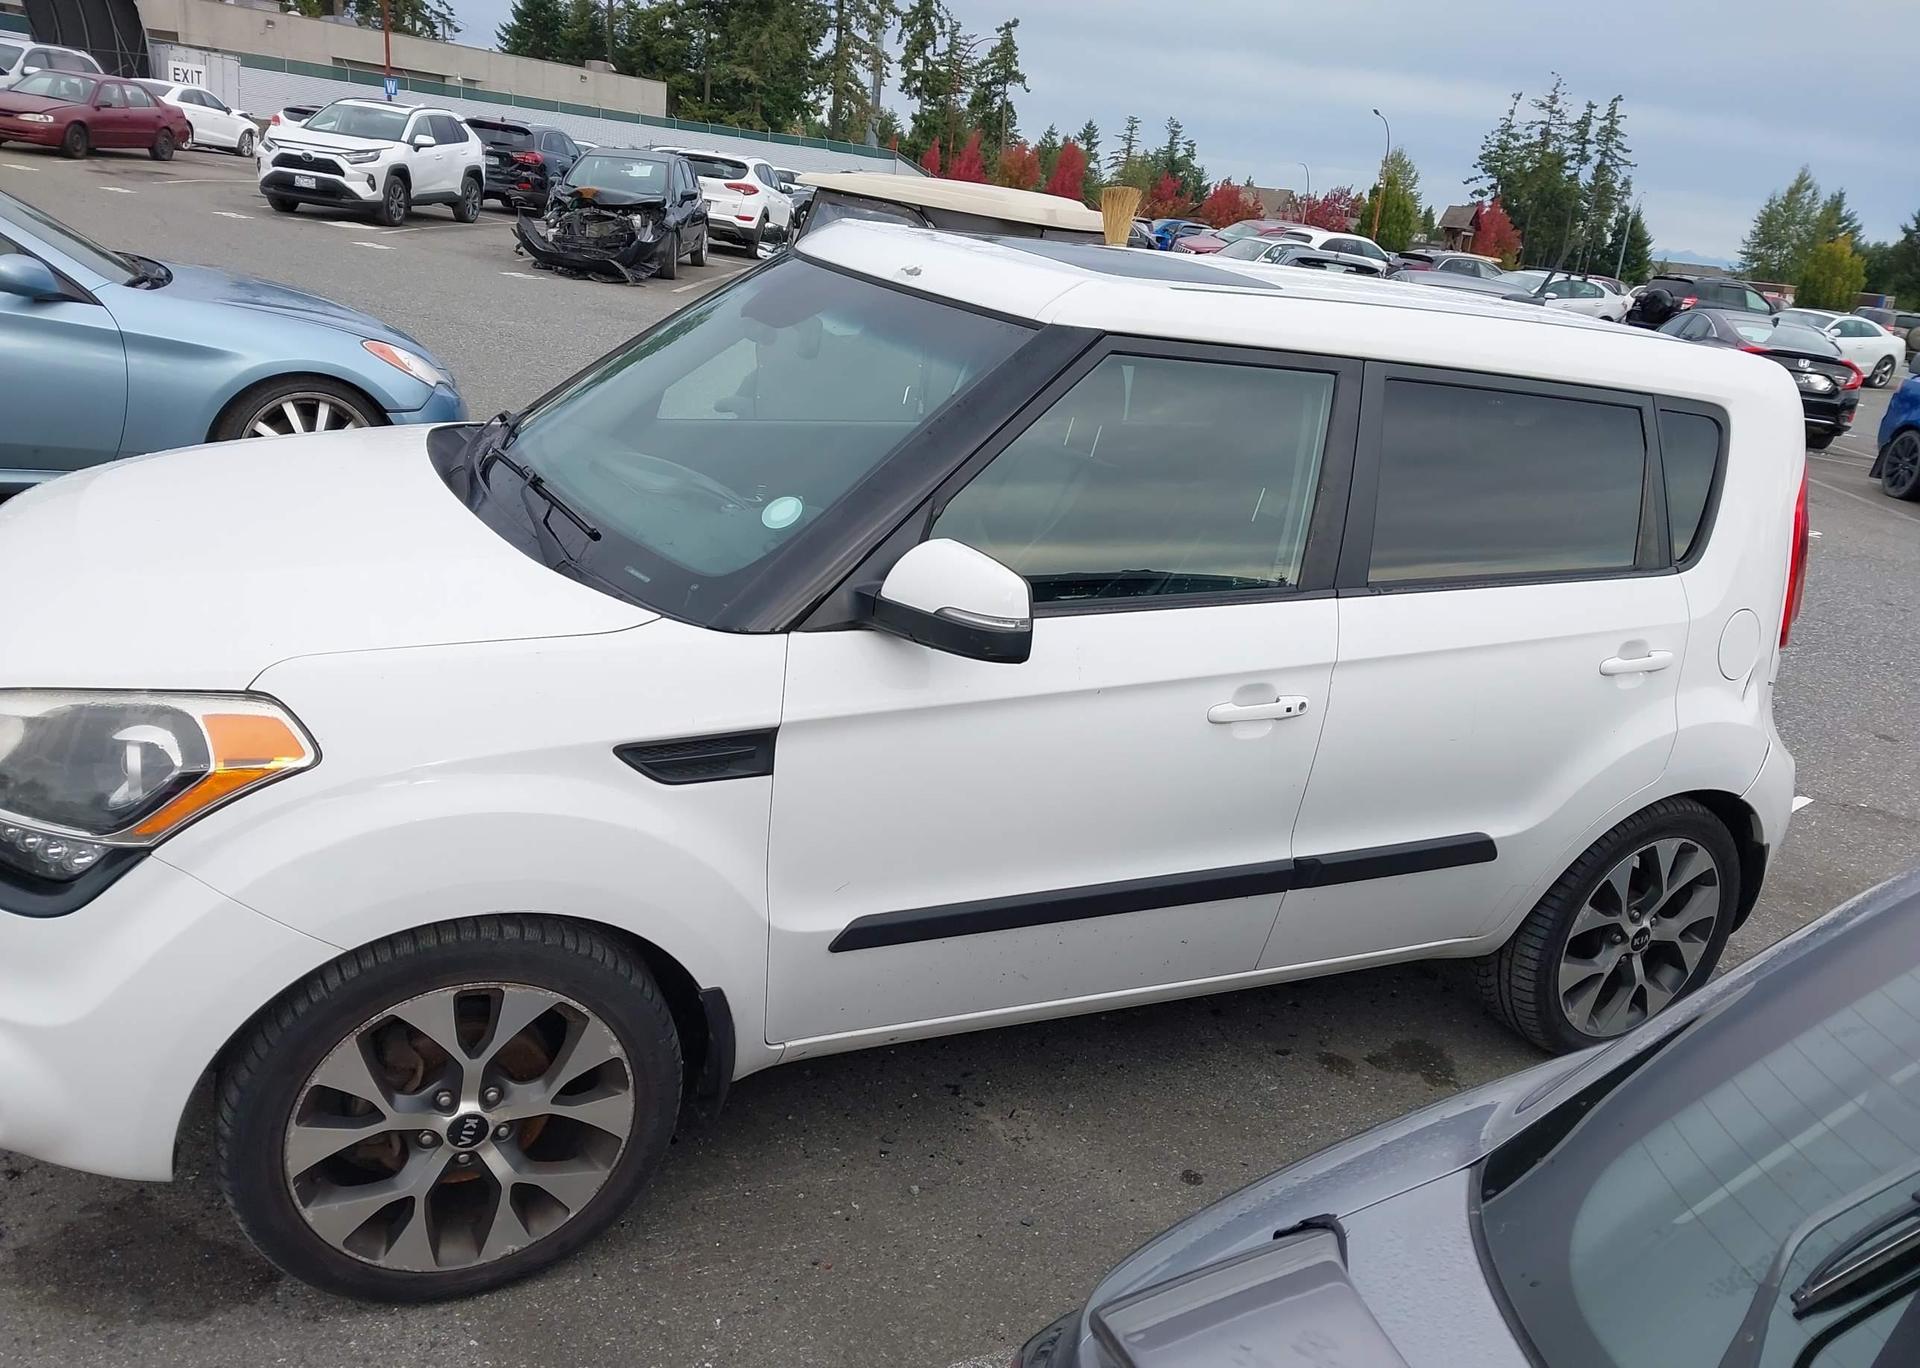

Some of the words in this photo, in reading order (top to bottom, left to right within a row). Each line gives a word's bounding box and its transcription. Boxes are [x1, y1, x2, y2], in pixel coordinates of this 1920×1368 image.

[173, 67, 202, 85] EXIT
[386, 80, 396, 94] W
[1633, 934, 1649, 945] KIA
[457, 1118, 479, 1146] KIA
